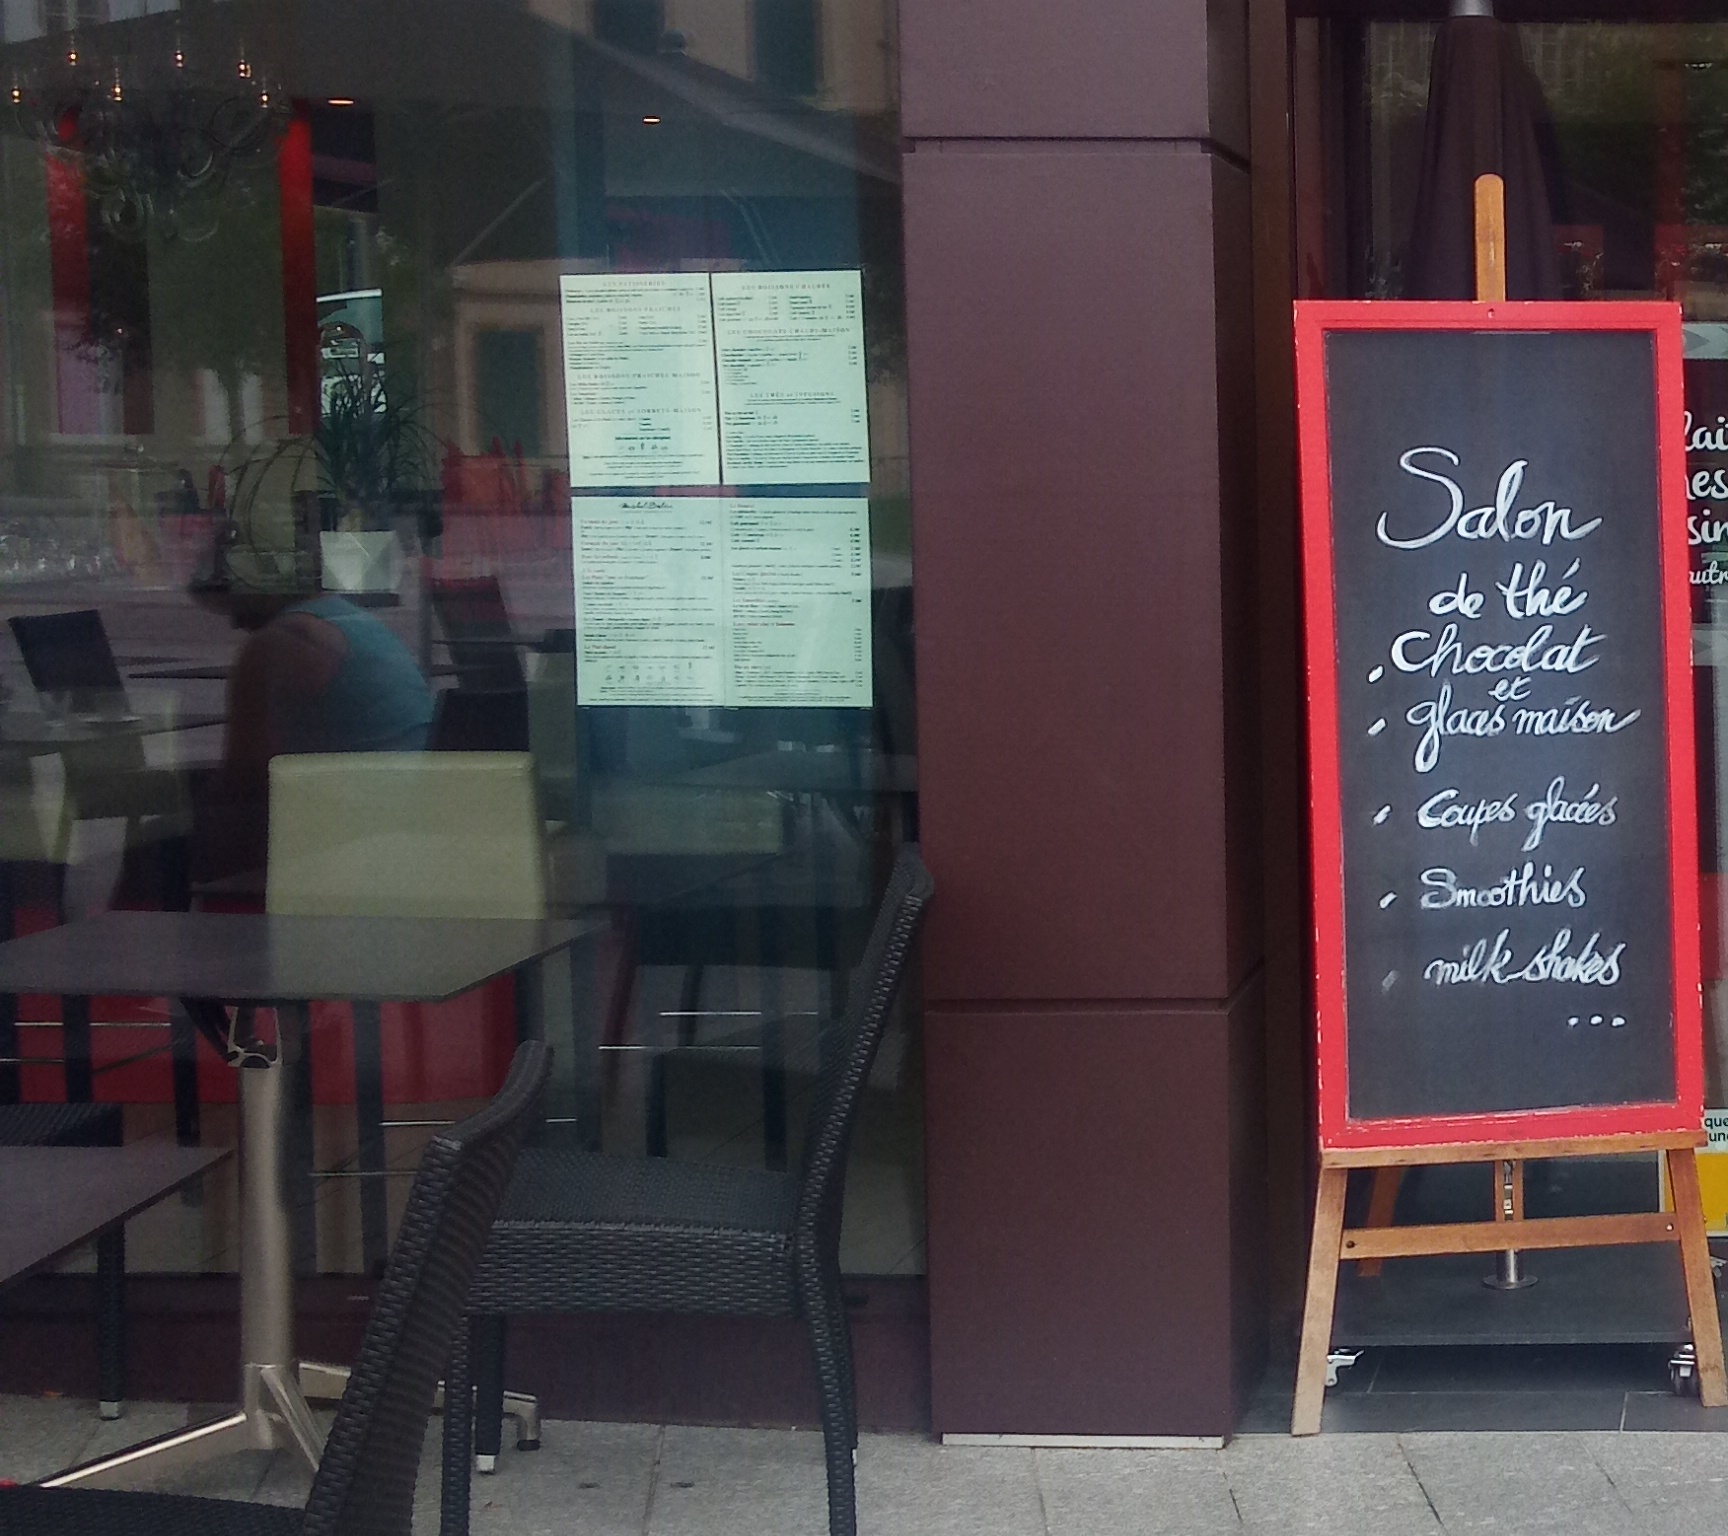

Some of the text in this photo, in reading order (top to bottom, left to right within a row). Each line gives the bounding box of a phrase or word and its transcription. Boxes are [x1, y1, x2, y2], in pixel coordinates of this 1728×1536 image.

[1377, 446, 1602, 549] Salon
[1428, 557, 1588, 619] de thé
[1488, 677, 1532, 701] et
[1406, 680, 1641, 772] glaces maison
[1417, 776, 1618, 851] Coupes glacées
[1420, 861, 1587, 909] Smoothies
[1424, 926, 1627, 985] milk shakes
